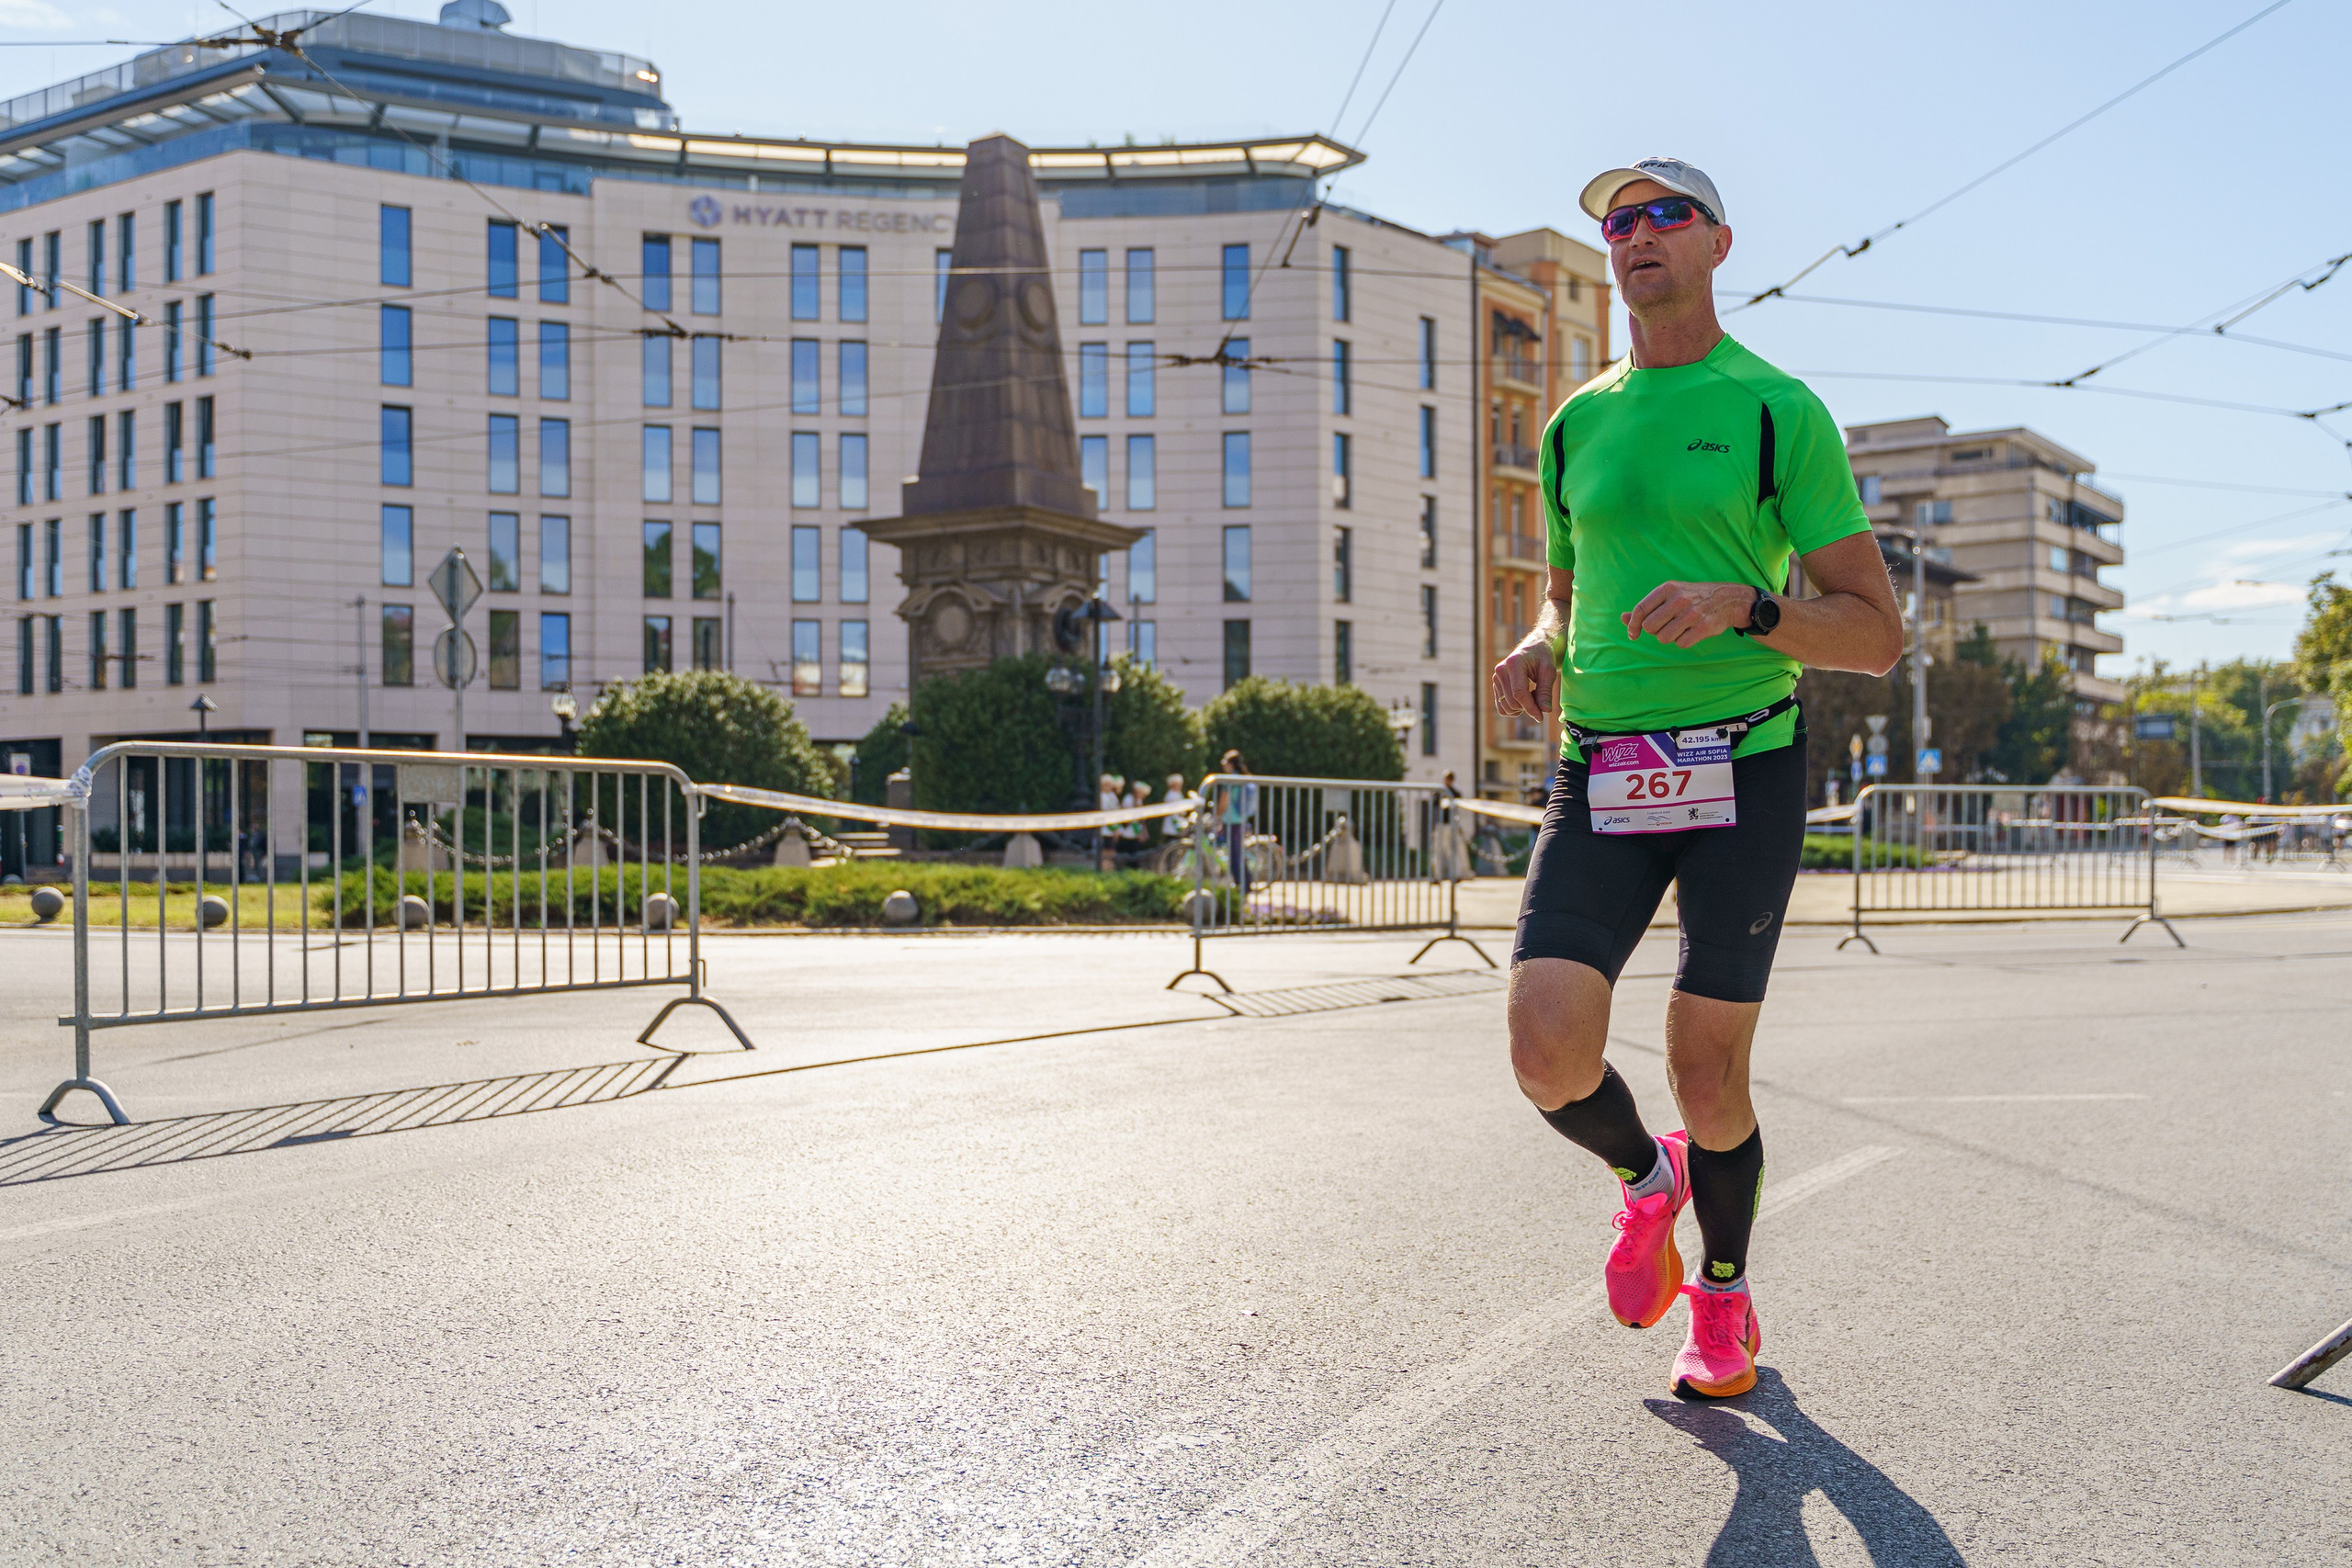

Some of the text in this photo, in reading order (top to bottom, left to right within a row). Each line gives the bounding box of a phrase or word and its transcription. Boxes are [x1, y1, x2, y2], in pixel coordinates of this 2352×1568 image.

[734, 206, 953, 232] HYATT REGENC
[1625, 770, 1692, 800] 267
